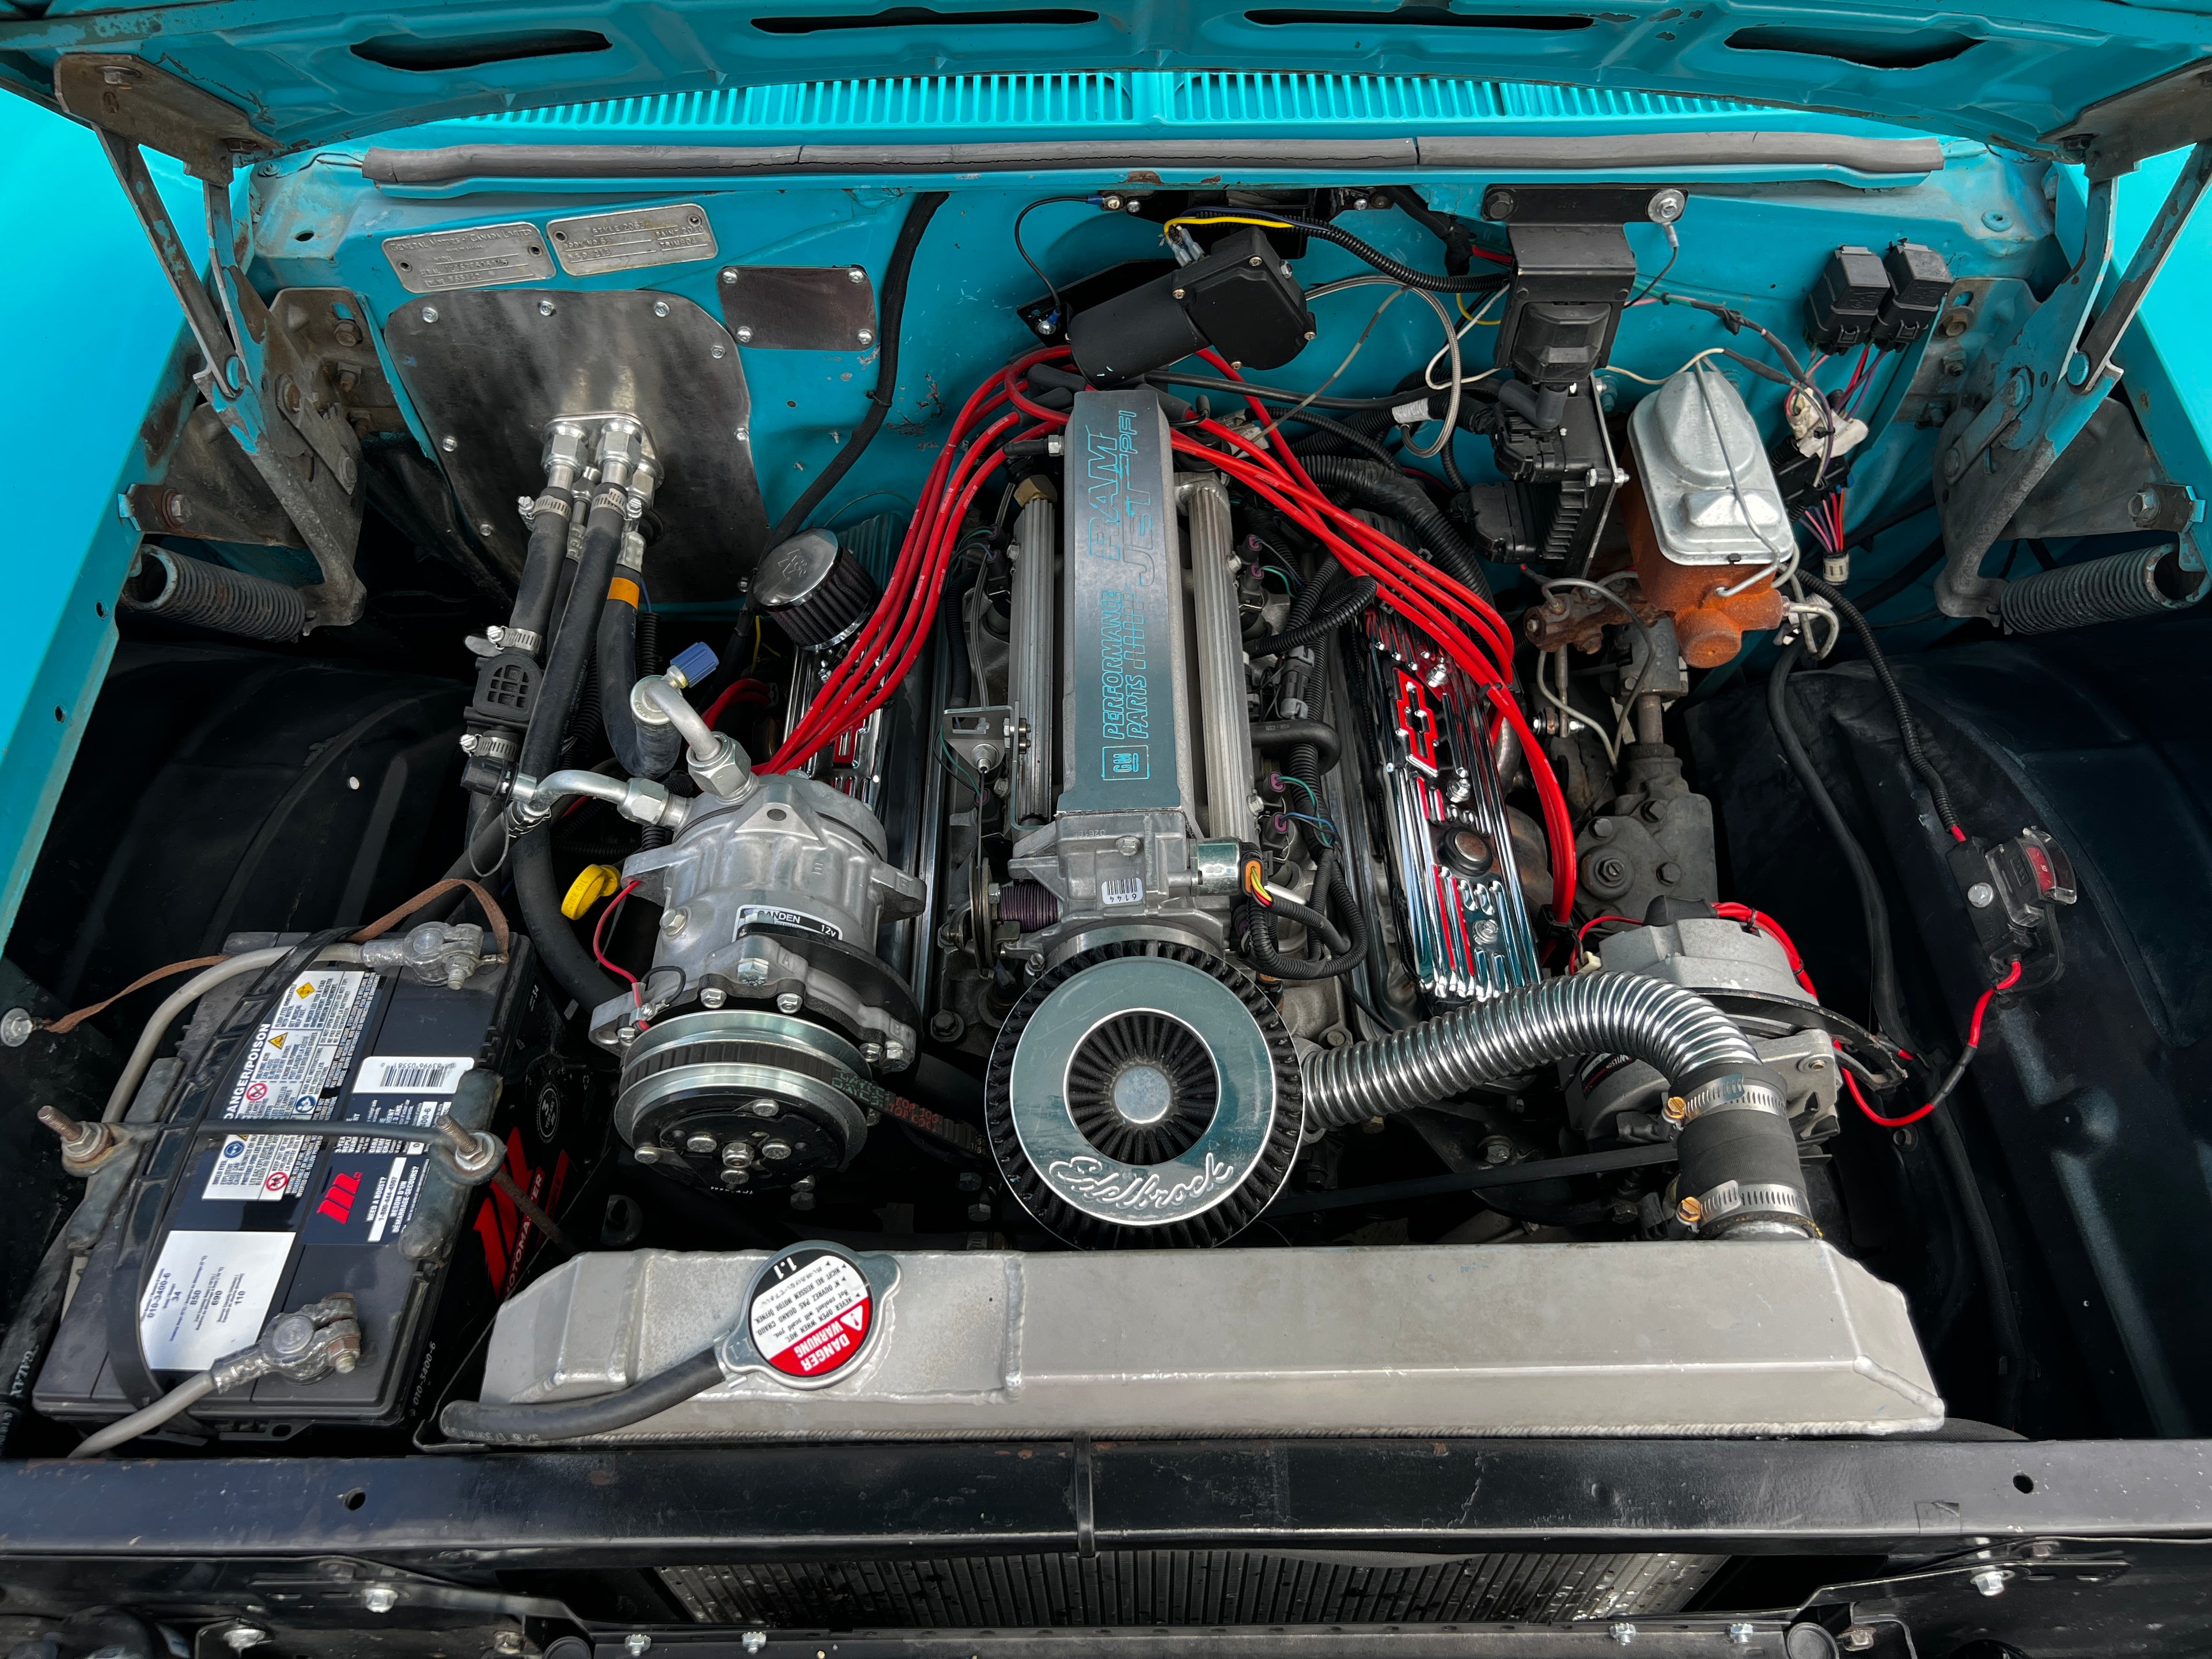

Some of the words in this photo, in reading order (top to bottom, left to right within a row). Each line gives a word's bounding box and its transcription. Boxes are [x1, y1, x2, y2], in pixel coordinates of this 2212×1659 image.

[1118, 411, 1138, 454] PFI
[1085, 425, 1121, 561] RAM
[1119, 454, 1155, 586] JET
[1101, 589, 1125, 739] PERFORMANCE
[1125, 675, 1149, 739] PARTS
[1113, 752, 1132, 772] GM
[290, 1005, 302, 1019] MEDICAL
[325, 1018, 334, 1028] OPEN
[1604, 1052, 1629, 1072] WILSON
[223, 1024, 271, 1119] DANGER/POISON
[310, 1070, 322, 1084] TOUTES
[300, 1084, 309, 1094] READ
[307, 1086, 316, 1094] LIRE
[1049, 1153, 1234, 1209] Edelbrock
[366, 1205, 378, 1221] NEED
[373, 1176, 388, 1198] BOOST?
[378, 1176, 398, 1221] 1-800-444-4597
[388, 1195, 404, 1217] BESOIN
[396, 1180, 408, 1194] D'UN
[392, 1166, 420, 1233] DÉMARRAGE-SECOURS?
[824, 1266, 840, 1279] NICHT
[815, 1277, 825, 1286] BEI
[146, 1272, 171, 1317] 010-3400-6
[171, 1291, 181, 1301] 34
[190, 1290, 202, 1305] 850
[211, 1290, 223, 1305] 690
[234, 1290, 245, 1305] 110
[837, 1288, 849, 1299] Hot
[774, 1297, 793, 1311] MOTOR
[798, 1298, 810, 1309] PAS
[815, 1297, 837, 1313] coolant
[834, 1296, 853, 1310] NEVER
[777, 1306, 798, 1323] QUAND
[803, 1310, 814, 1321] will
[817, 1308, 834, 1321] OPEN
[755, 1320, 777, 1337] CHAUD.
[786, 1318, 803, 1331] scald
[798, 1319, 817, 1333] WHEN
[772, 1327, 786, 1339] you.
[784, 1331, 798, 1343] HOT.
[791, 1319, 844, 1358] WARNUNG
[798, 1332, 851, 1372] DANGER
